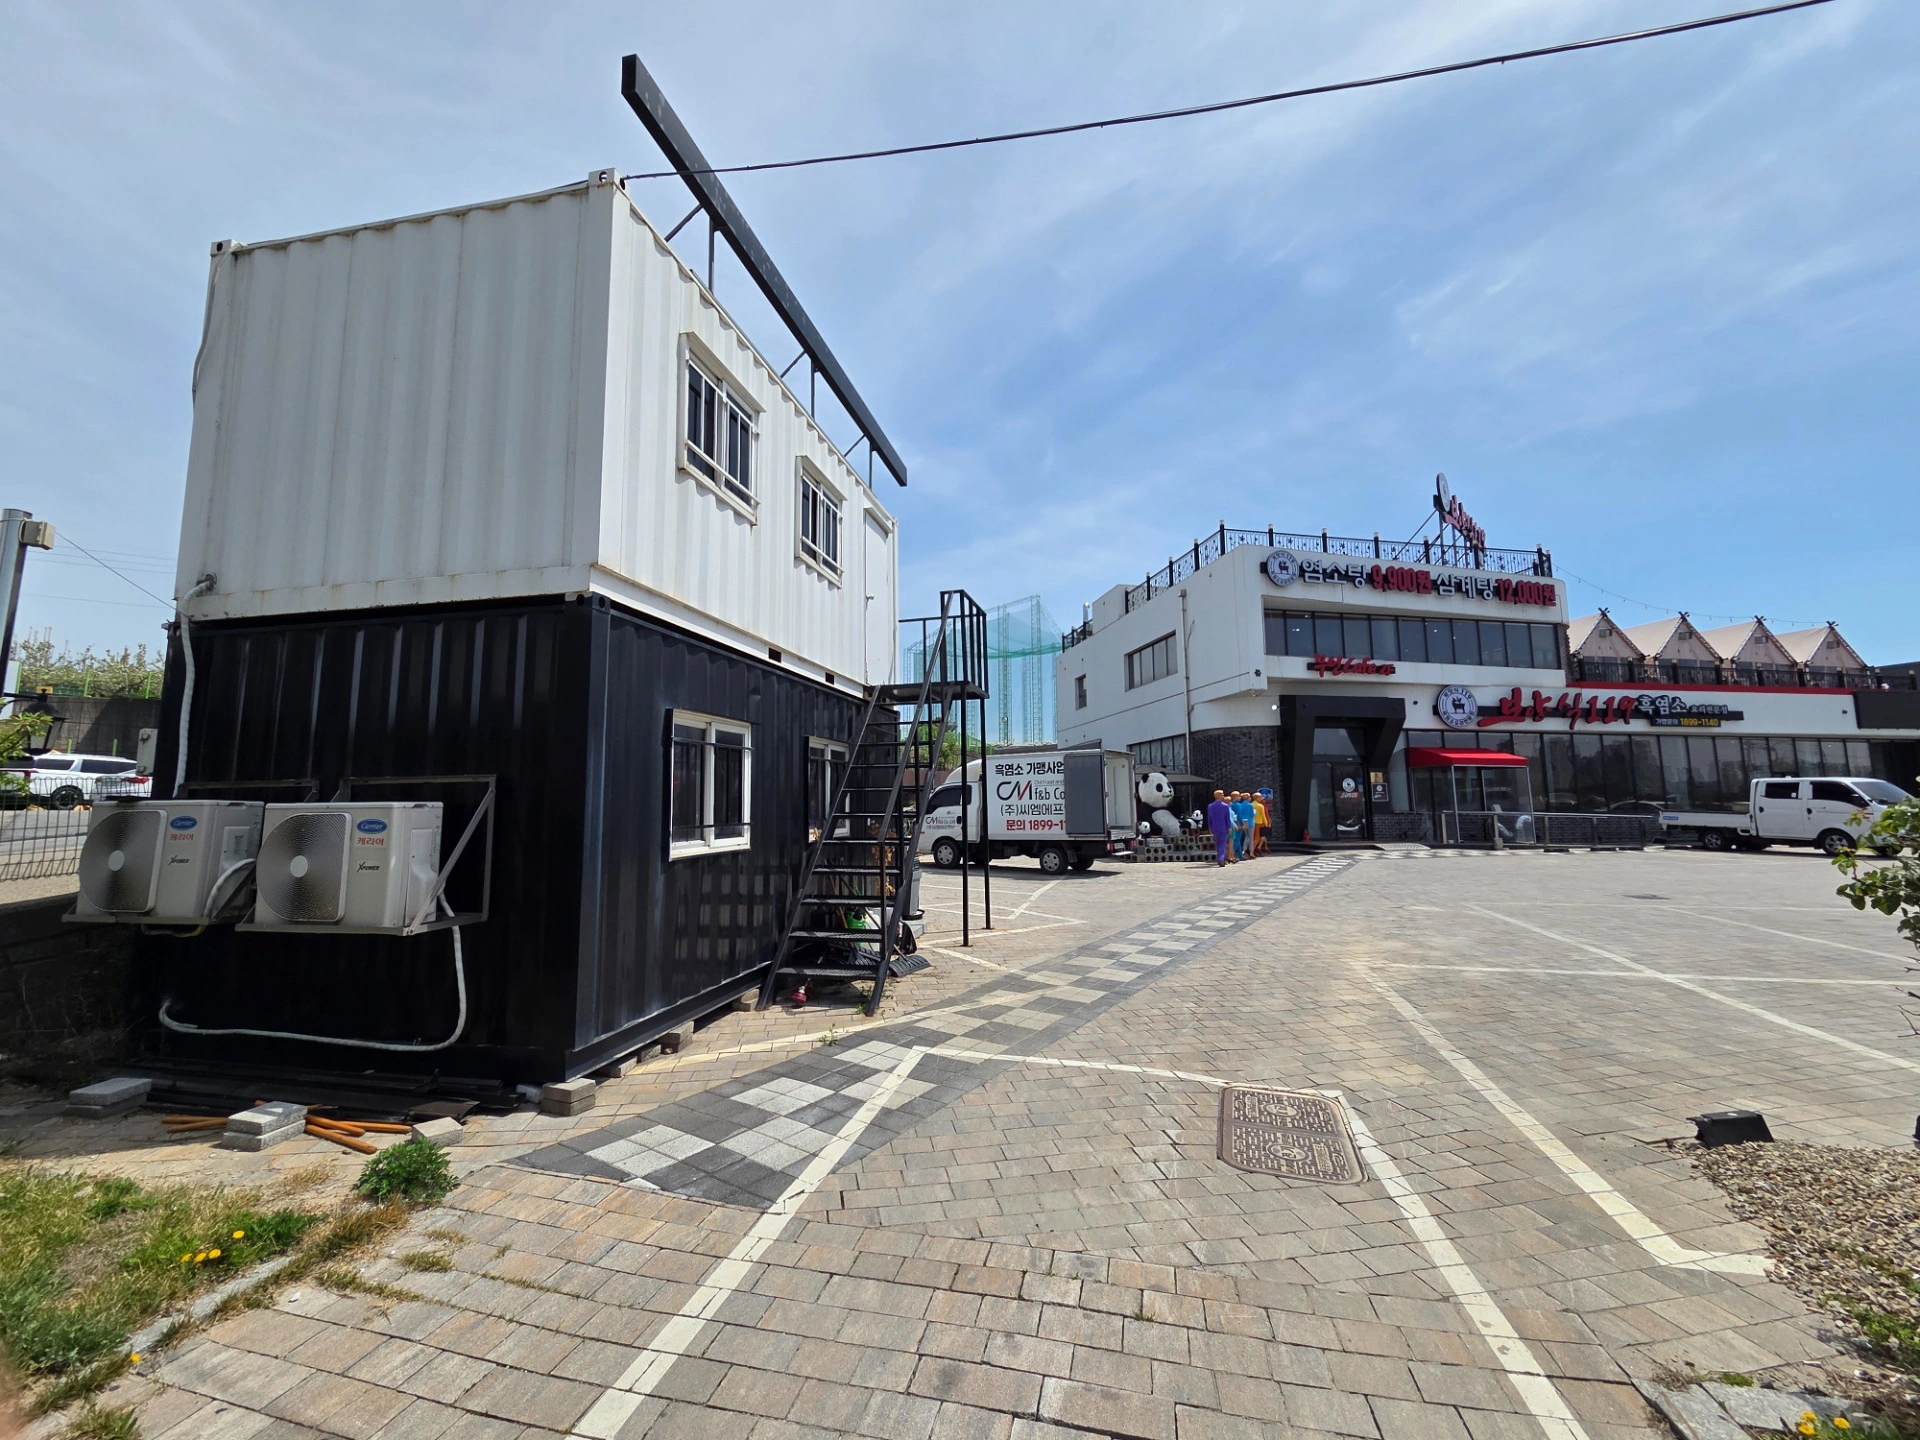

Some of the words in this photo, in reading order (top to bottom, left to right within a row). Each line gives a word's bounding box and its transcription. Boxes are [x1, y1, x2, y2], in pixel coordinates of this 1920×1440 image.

[1301, 558, 1368, 588] 염소탕
[1371, 564, 1432, 594] 9,900원
[1436, 572, 1497, 600] 삼계탕
[1496, 578, 1556, 607] 12,000원
[1638, 694, 1687, 715] 흑염소
[1680, 717, 1719, 727] 1899-1140
[995, 763, 1024, 776] 흑염소
[1034, 787, 1050, 800] f&b
[360, 822, 383, 830] Carrier
[1006, 820, 1026, 831] 문의
[357, 837, 384, 846] 캐리어
